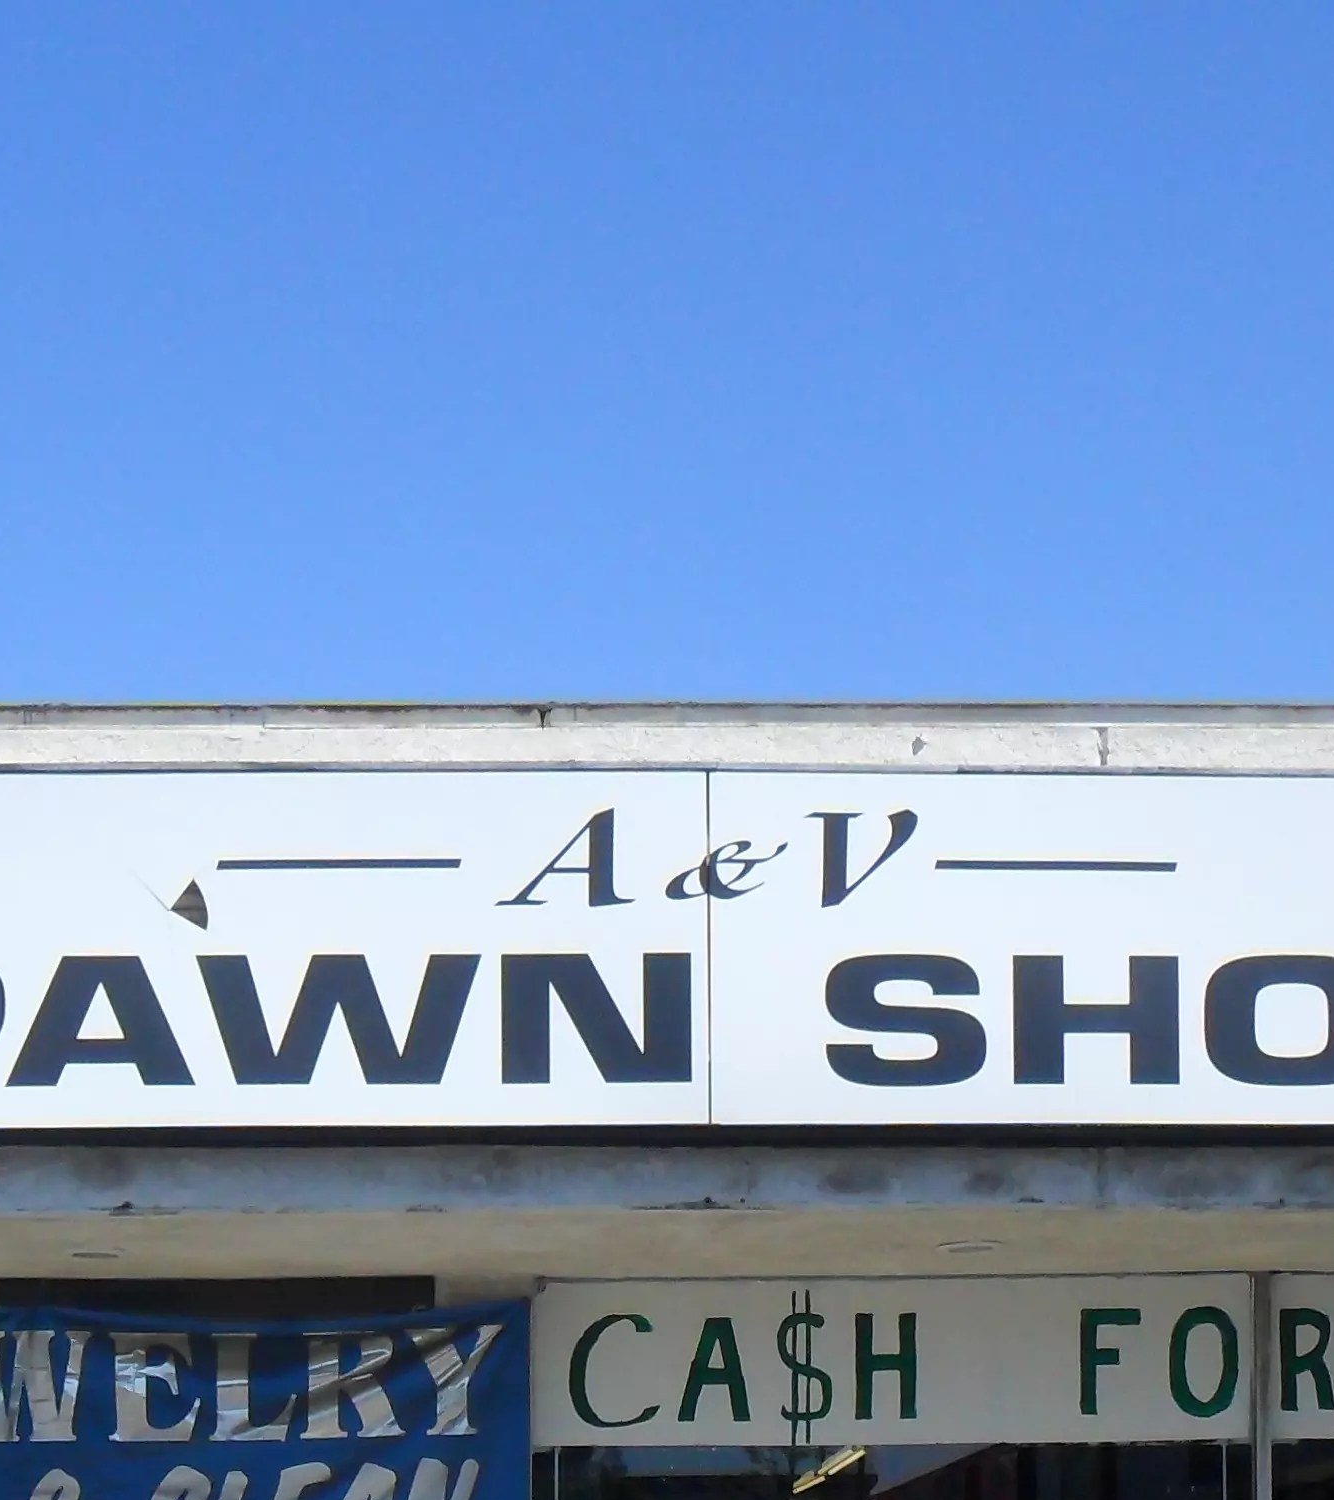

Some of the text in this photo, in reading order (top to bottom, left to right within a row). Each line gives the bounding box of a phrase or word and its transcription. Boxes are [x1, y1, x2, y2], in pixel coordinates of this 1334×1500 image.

[494, 807, 918, 908] A & V
[568, 1289, 917, 1446] CA$H
